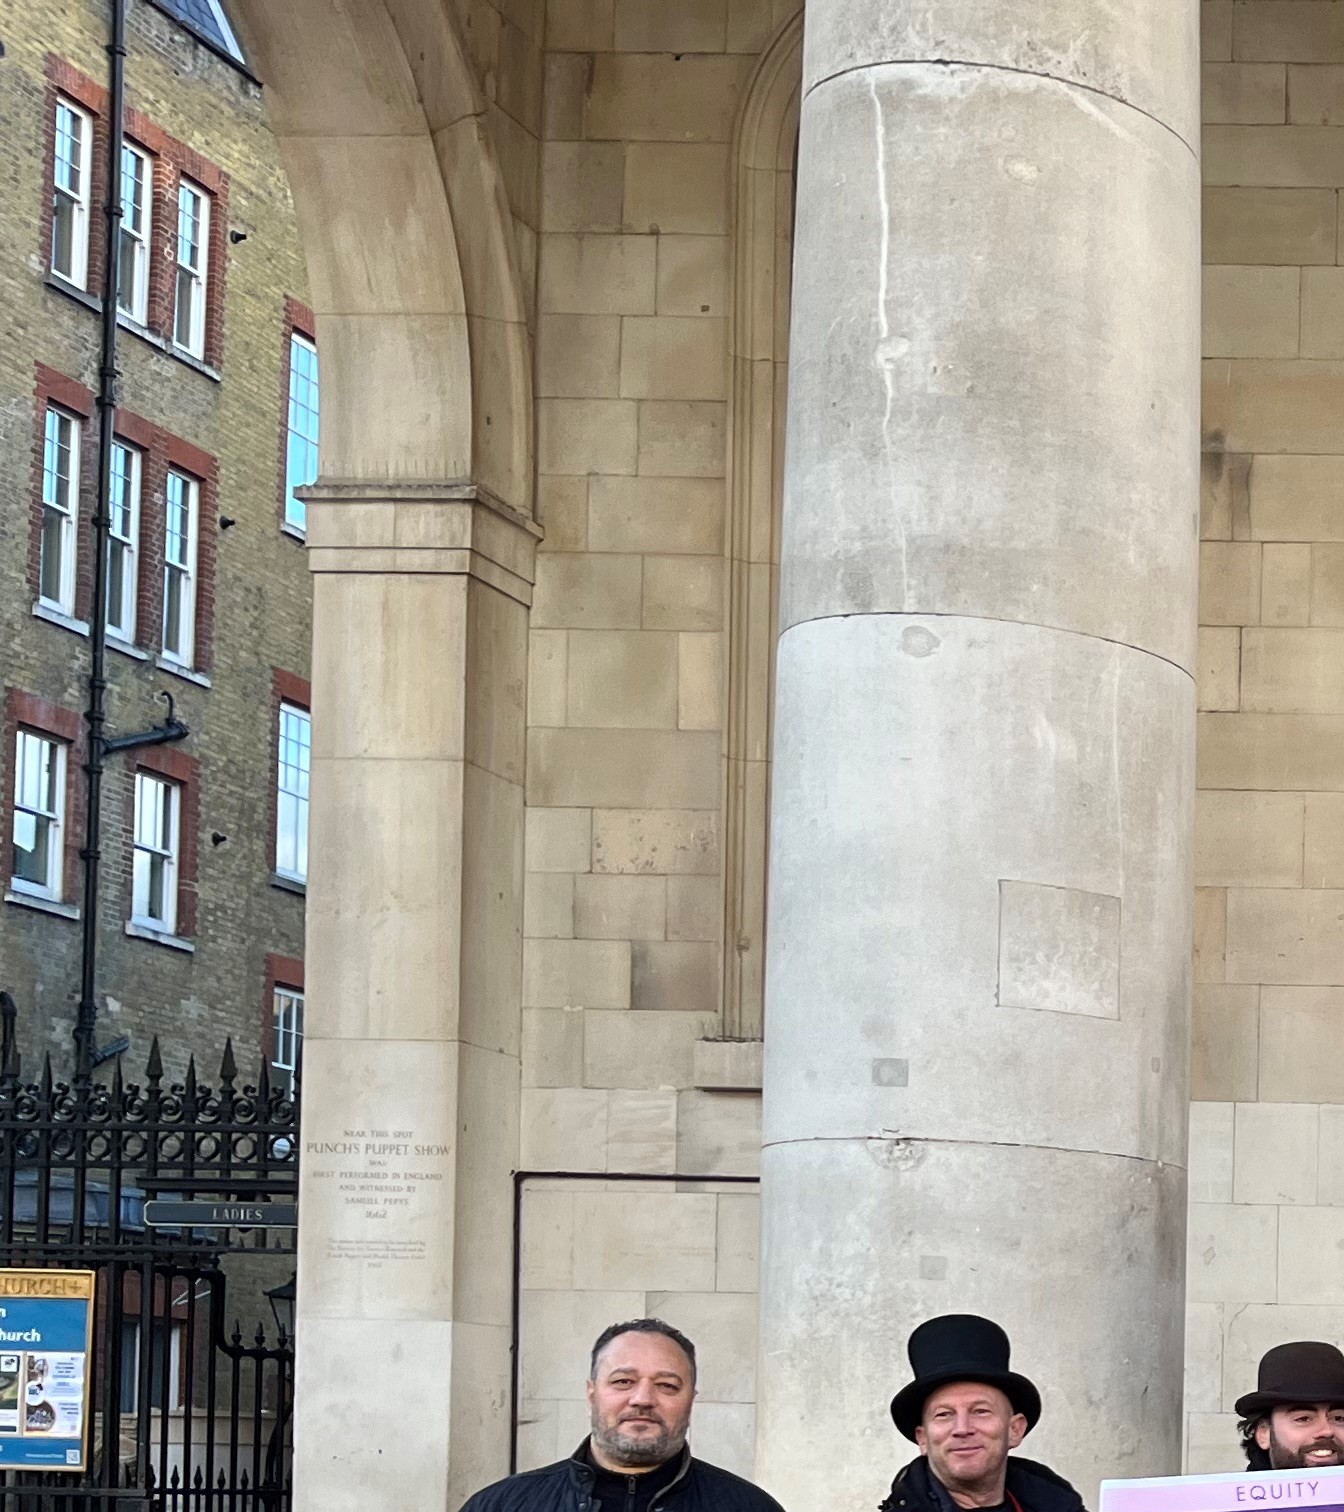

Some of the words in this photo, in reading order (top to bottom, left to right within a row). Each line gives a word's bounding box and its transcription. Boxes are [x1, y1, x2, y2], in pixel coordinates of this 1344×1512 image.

[365, 1143, 410, 1156] PUPPET
[414, 1144, 451, 1156] SHOW
[403, 1172, 443, 1181] ENGLAND
[212, 1207, 263, 1221] LADIES
[1236, 1481, 1319, 1502] EQUITY
